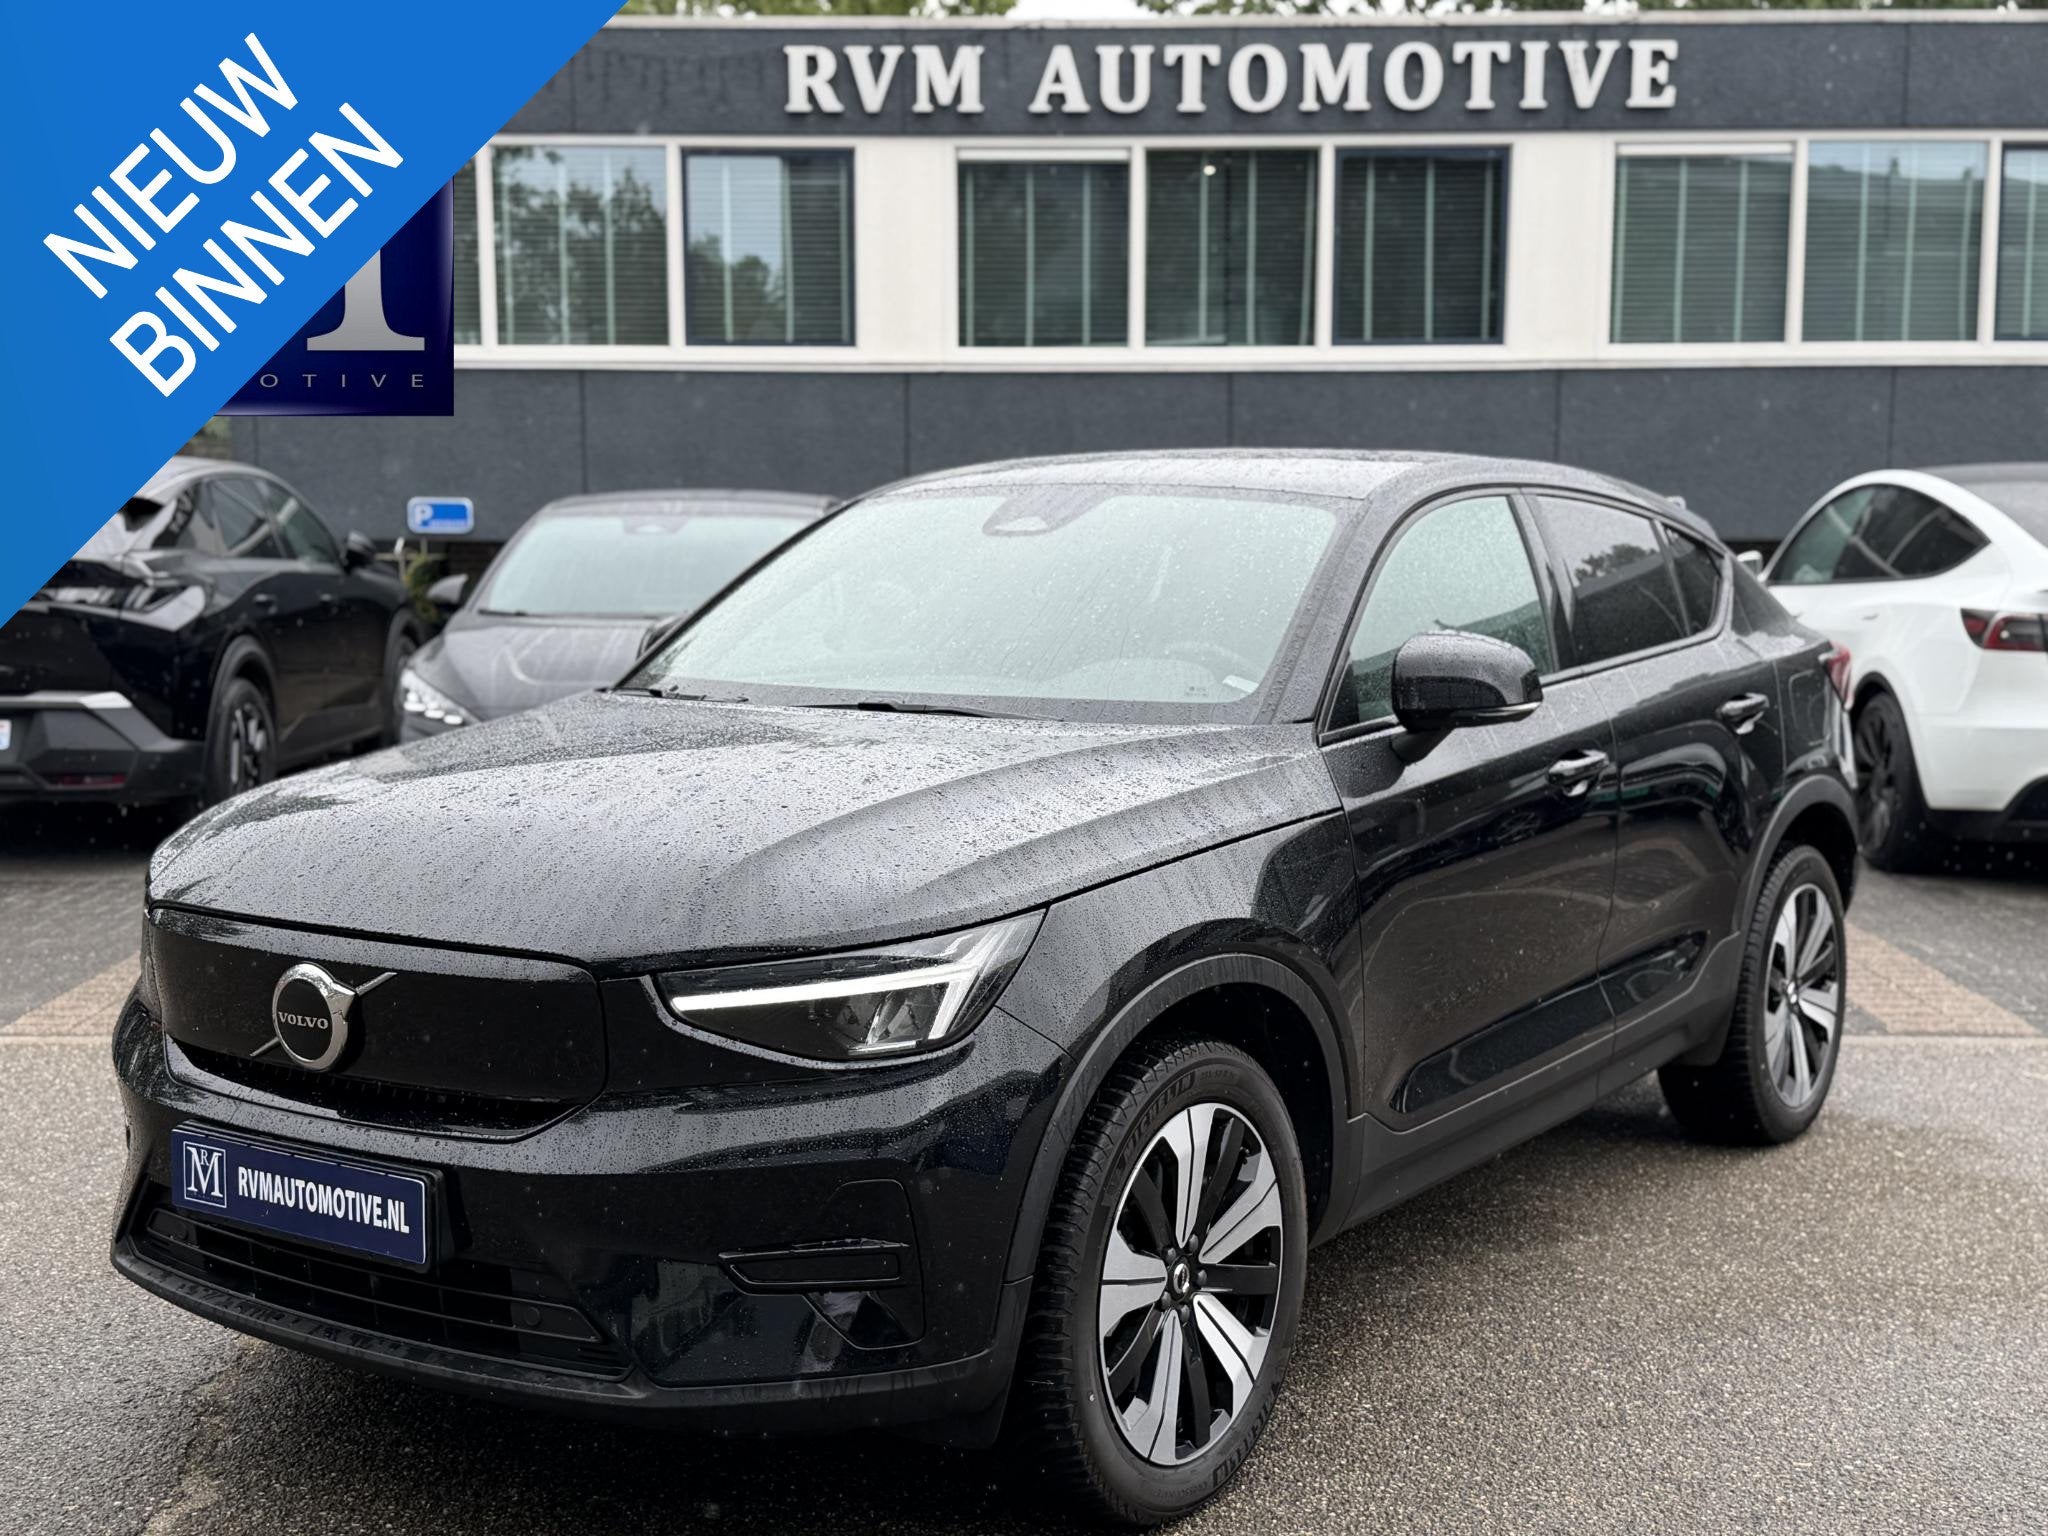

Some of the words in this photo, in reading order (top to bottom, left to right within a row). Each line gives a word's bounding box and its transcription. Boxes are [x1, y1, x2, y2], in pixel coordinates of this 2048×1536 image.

[783, 44, 984, 114] RVM
[1029, 38, 1679, 114] AUTOMOTIVE
[277, 1011, 329, 1030] VOLVO
[237, 1165, 410, 1234] RVMAUTOMOTIVE.NL
